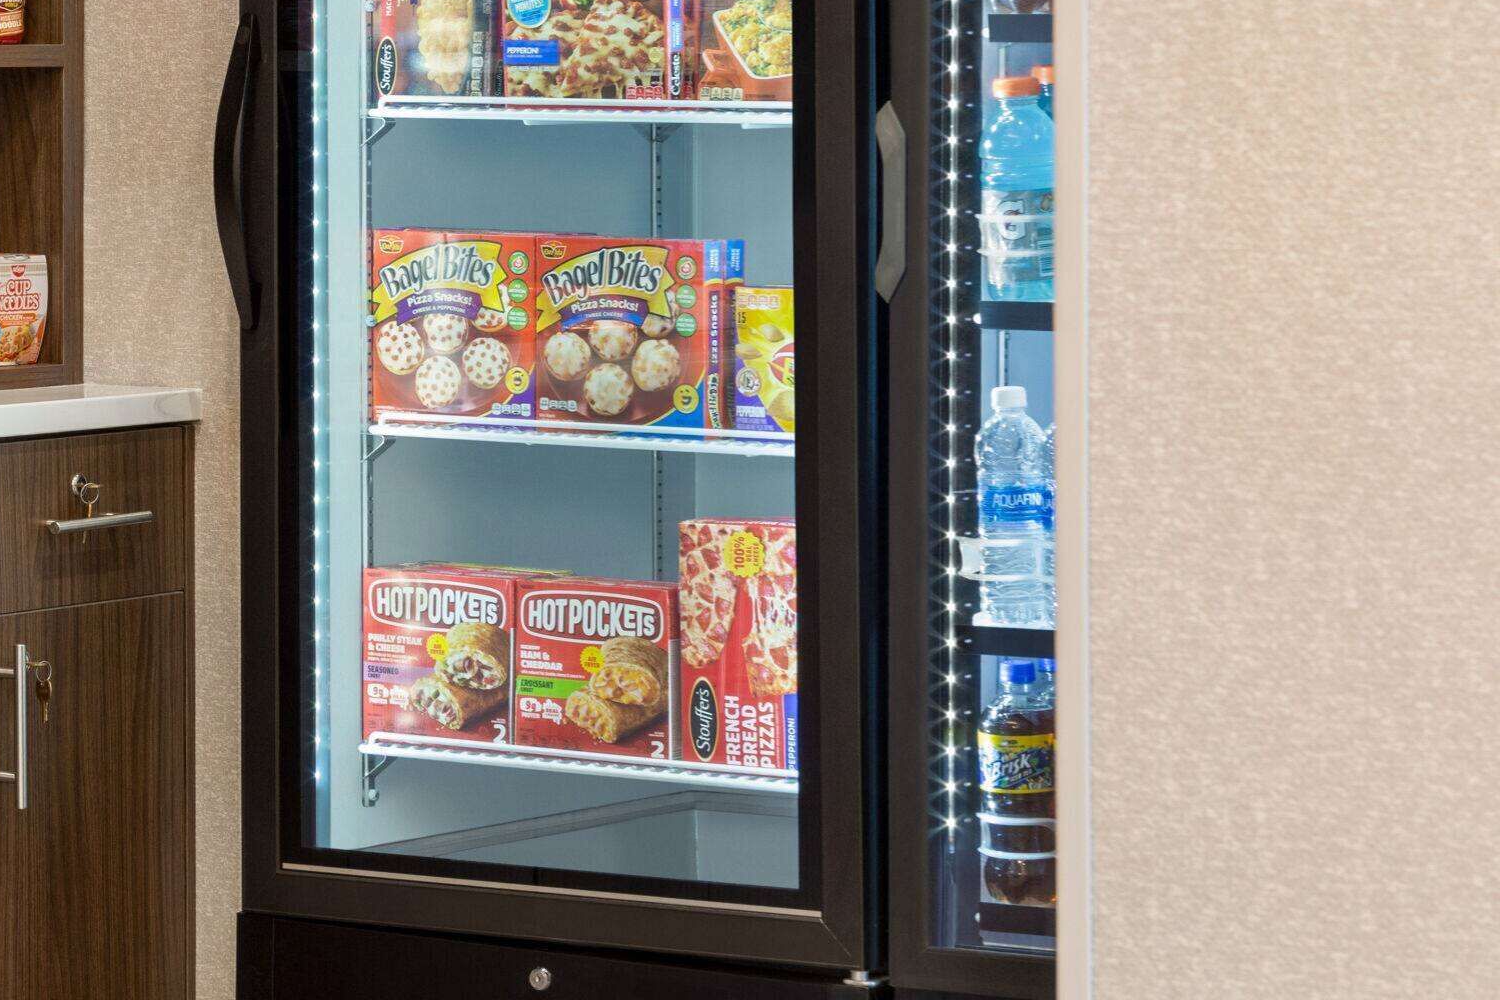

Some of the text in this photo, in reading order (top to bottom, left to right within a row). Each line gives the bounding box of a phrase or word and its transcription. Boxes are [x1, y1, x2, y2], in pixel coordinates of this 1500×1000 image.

[379, 44, 394, 91] Stouffer's
[506, 46, 540, 55] PEPPERONI
[671, 54, 681, 96] Celeste
[6, 278, 32, 295] CUP
[379, 243, 495, 299] Bagel Bites
[542, 247, 661, 307] Bagel Bites
[407, 292, 473, 306] Pizza Snacks!
[570, 298, 639, 313] Pizza Snacks!
[710, 294, 718, 336] Snacks
[734, 535, 745, 570] 100%
[376, 586, 498, 626] HOT POCKETS
[528, 599, 655, 638] HOT POCKETS
[367, 633, 423, 646] PHILLY STEAK
[520, 650, 542, 660] HAM
[367, 664, 400, 676] SEASONED
[520, 660, 564, 672] CHEDDAR
[520, 679, 554, 689] CROISSANT
[493, 723, 507, 744] 2
[696, 688, 714, 752] Stouffer's
[724, 695, 741, 766] FRENCH
[741, 704, 758, 768] BREAD
[758, 701, 775, 769] PIZZAS
[650, 740, 665, 759] 2
[787, 717, 796, 770] PEPPERONI
[992, 753, 1033, 779] Brisk
